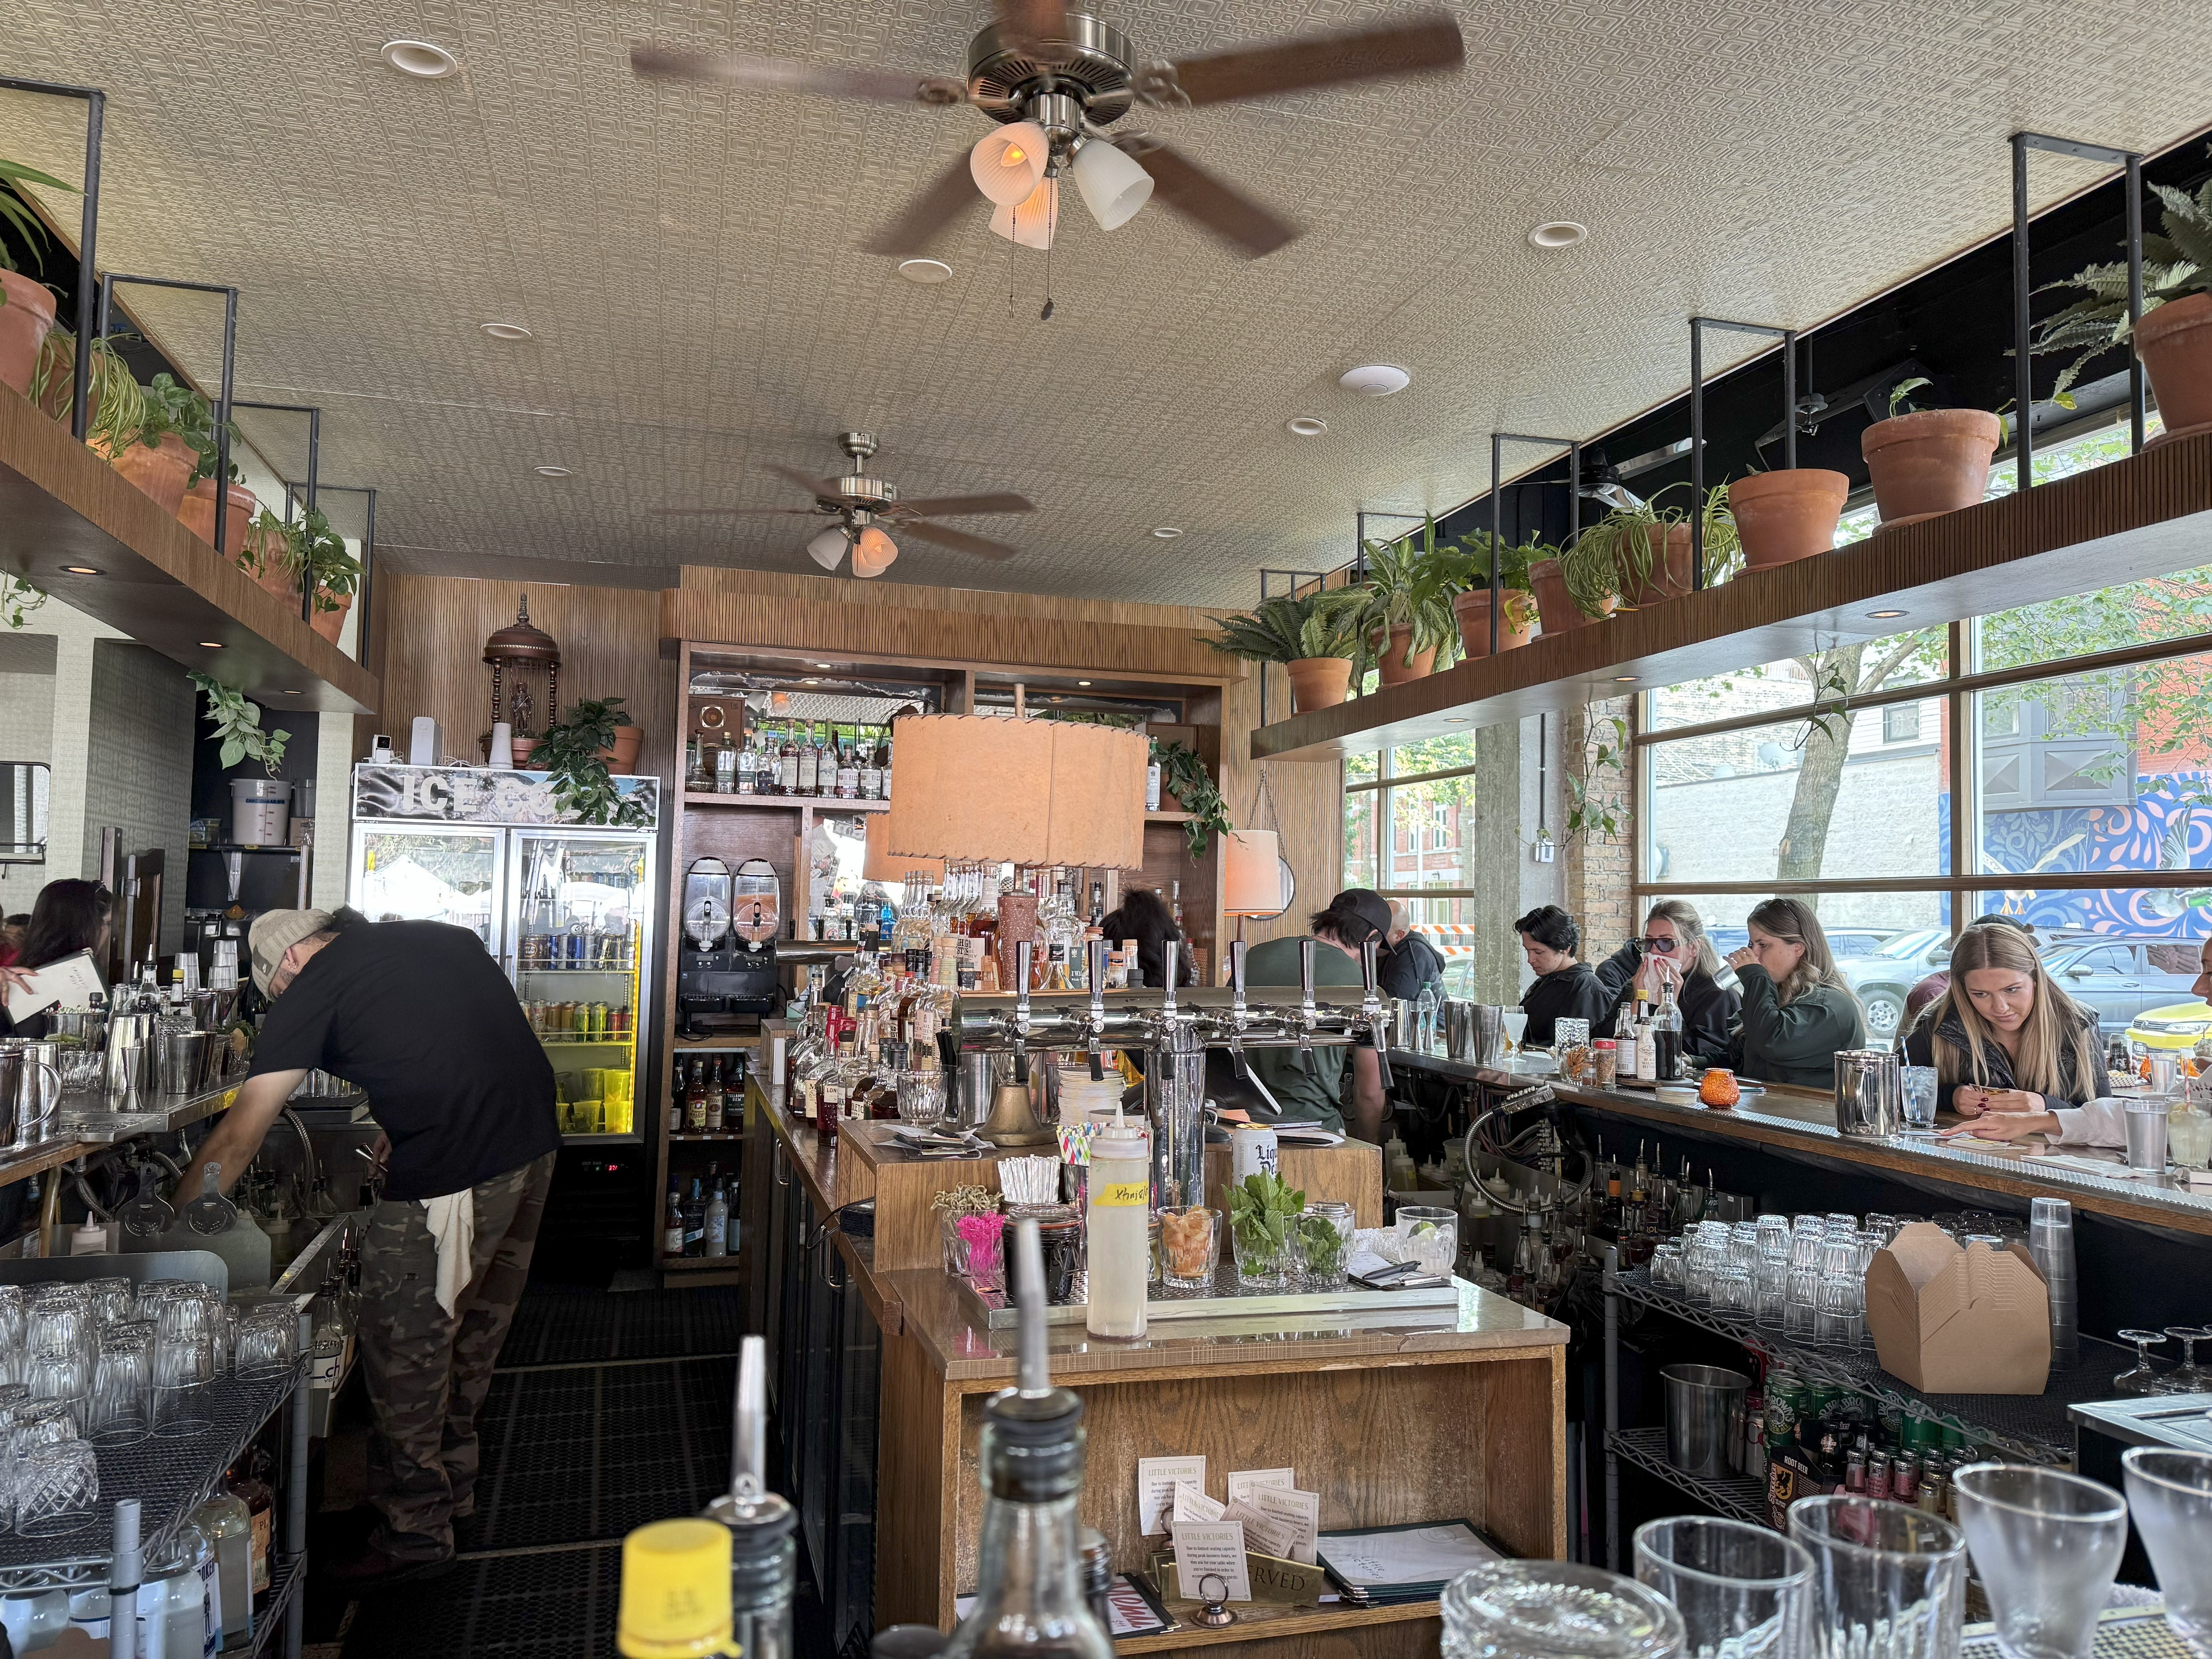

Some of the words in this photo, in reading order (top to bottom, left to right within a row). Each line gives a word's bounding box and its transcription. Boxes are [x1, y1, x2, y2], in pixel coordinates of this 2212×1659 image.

[402, 775, 478, 812] ICE
[1255, 1144, 1277, 1164] Liqu
[1784, 1455, 1797, 1468] ROOT
[1798, 1462, 1808, 1475] BEER
[1768, 1463, 1777, 1504] Sprecher
[1182, 1493, 1198, 1508] LITTLE
[1259, 1494, 1276, 1504] LITTLE
[1278, 1498, 1308, 1510] VICTORIES
[1236, 1510, 1255, 1524] LITTLE
[1255, 1522, 1285, 1540] VICTORIES
[1362, 1556, 1385, 1571] Little
